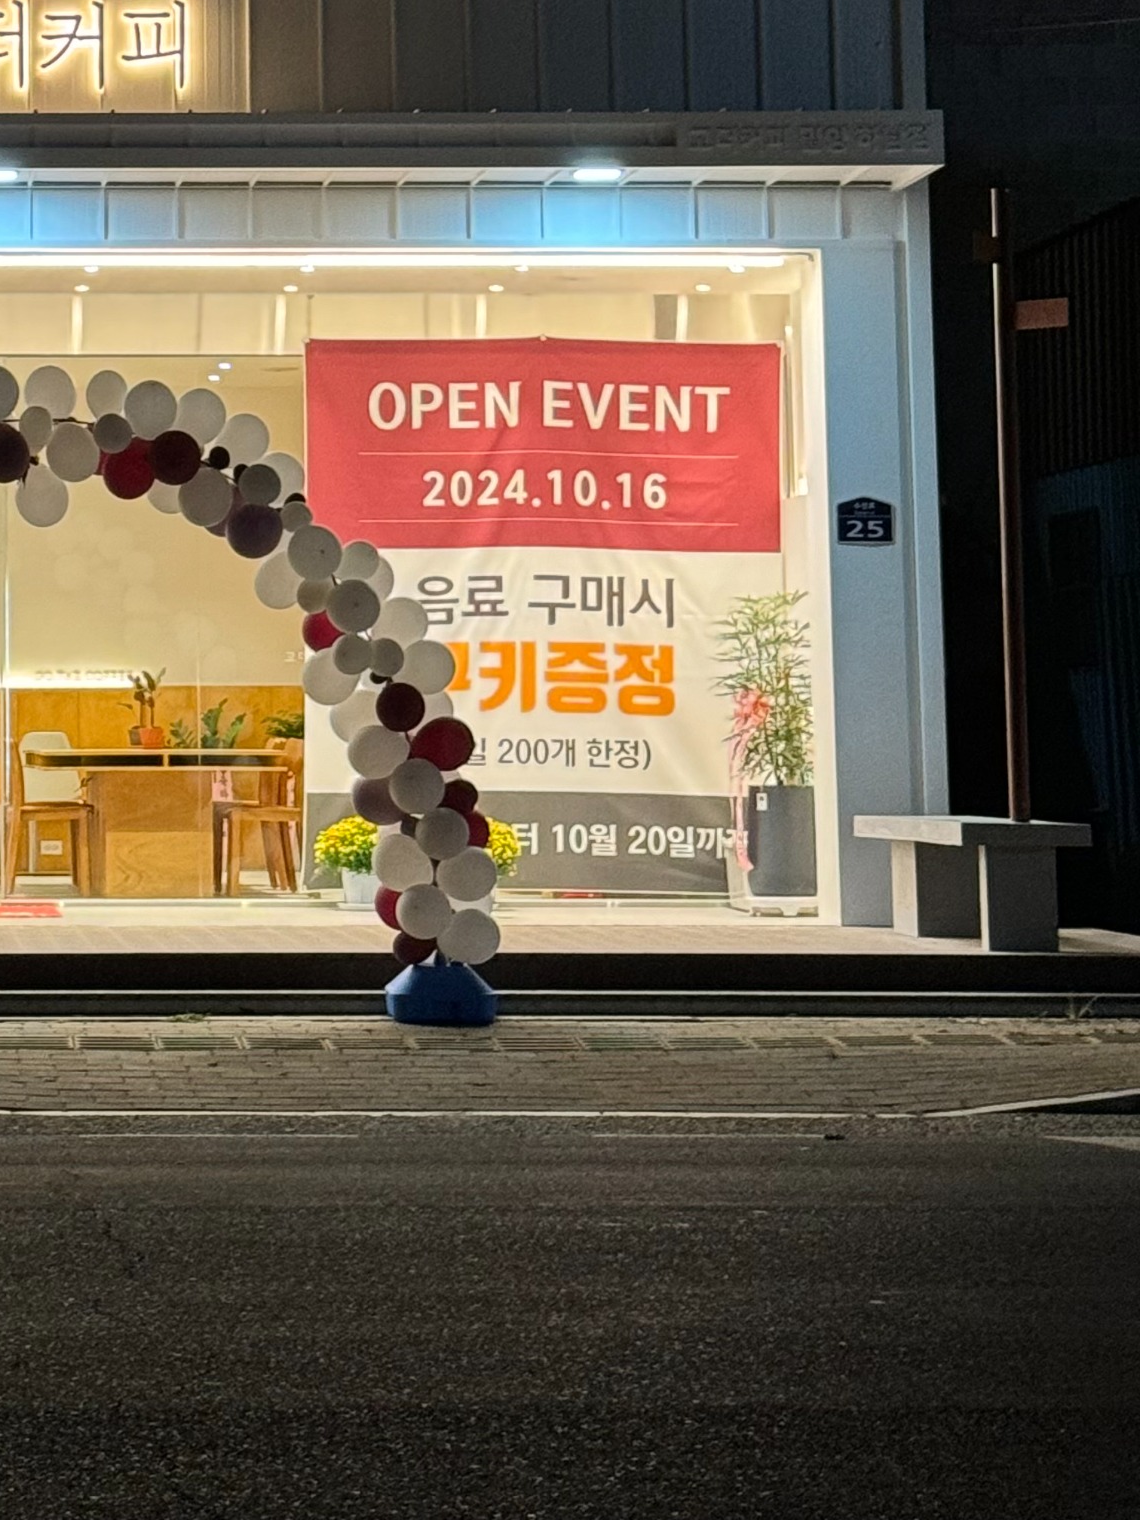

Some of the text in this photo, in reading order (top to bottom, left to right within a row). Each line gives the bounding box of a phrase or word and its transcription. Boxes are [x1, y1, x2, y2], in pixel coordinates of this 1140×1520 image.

[367, 379, 731, 433] OPEN EVENT
[421, 468, 667, 510] 2024.10.16
[846, 520, 884, 538] 25
[417, 574, 675, 628] 음료 구매시
[497, 737, 576, 768] 200개
[586, 737, 652, 771] 한정)
[551, 823, 618, 857] 10월
